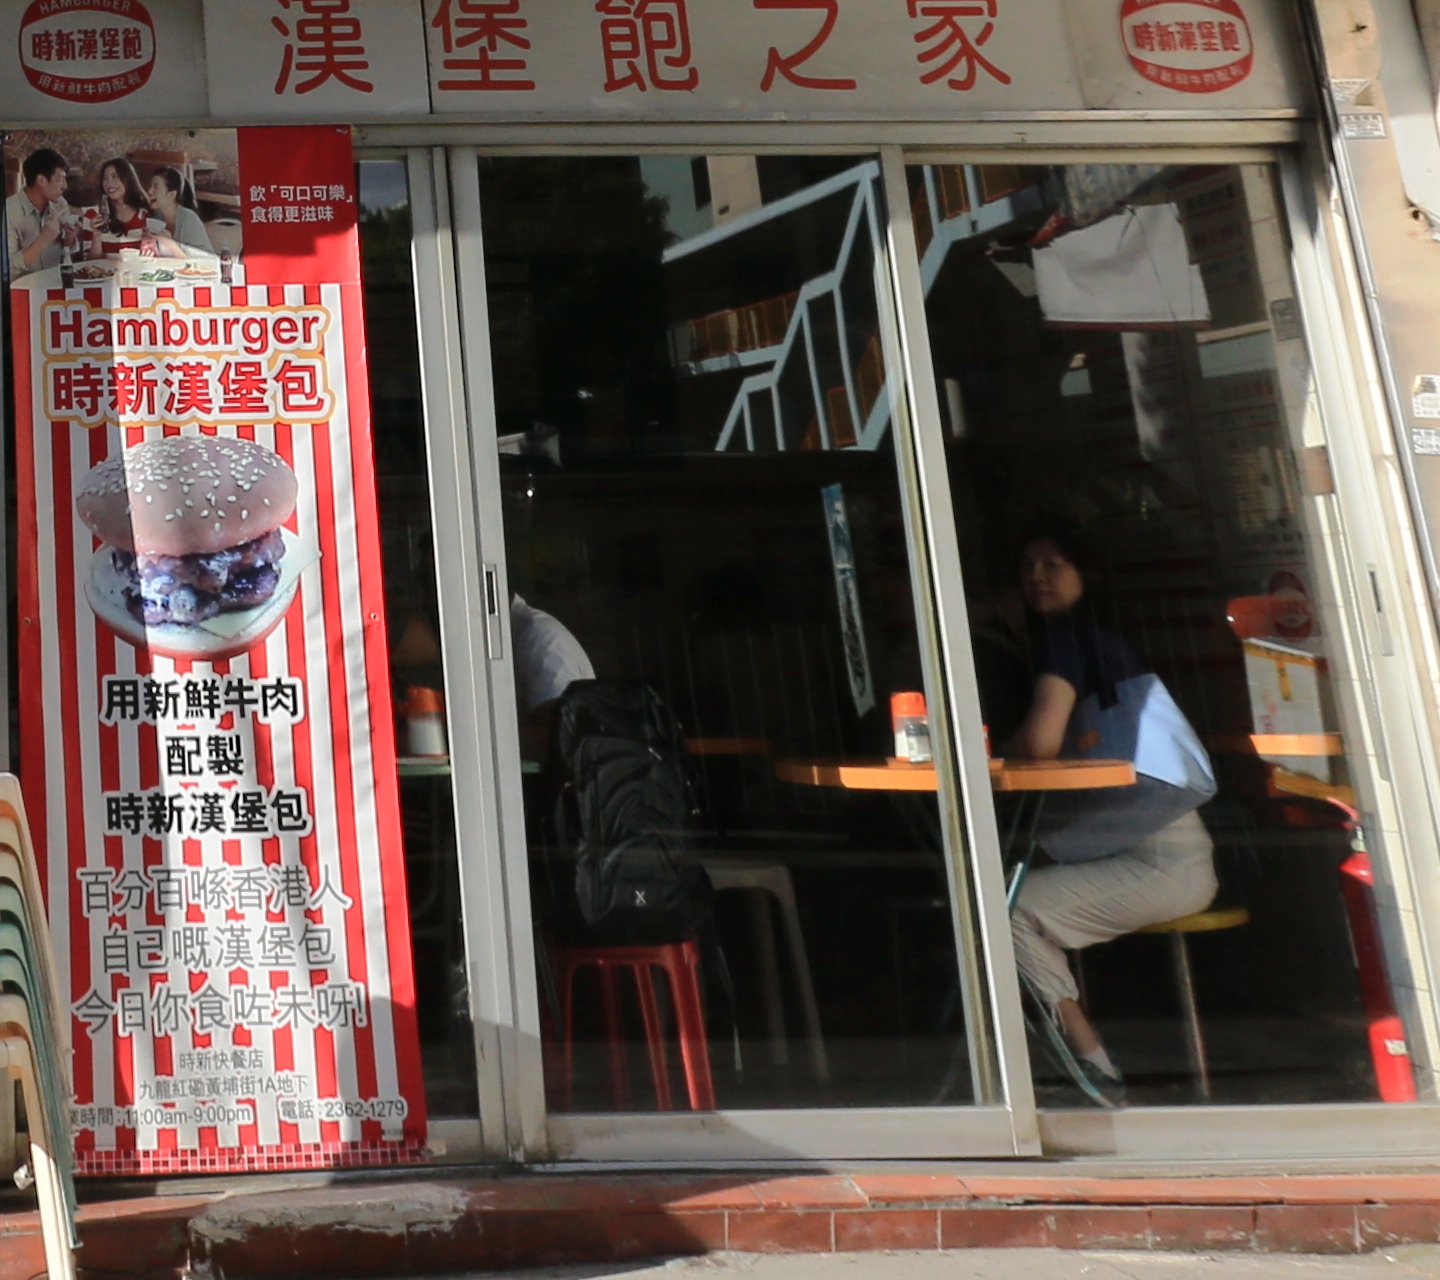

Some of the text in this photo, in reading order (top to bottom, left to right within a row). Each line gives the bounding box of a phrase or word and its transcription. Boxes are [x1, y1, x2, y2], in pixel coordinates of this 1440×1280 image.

[31, 27, 142, 61] 時新漢堡飽
[249, 185, 354, 204] 飲「可口可樂」
[250, 206, 334, 223] 食得更滋味
[50, 308, 320, 355] Hamburger
[52, 360, 325, 417] 時新漢堡包
[104, 678, 299, 720] 用新鮮牛肉
[165, 735, 245, 777] 配製
[106, 790, 308, 835] 時新漢堡包
[80, 864, 350, 914] 百分百喺香港人
[74, 982, 367, 1033] 今日你食咗未呀!
[178, 1049, 264, 1070] 時新快餐店
